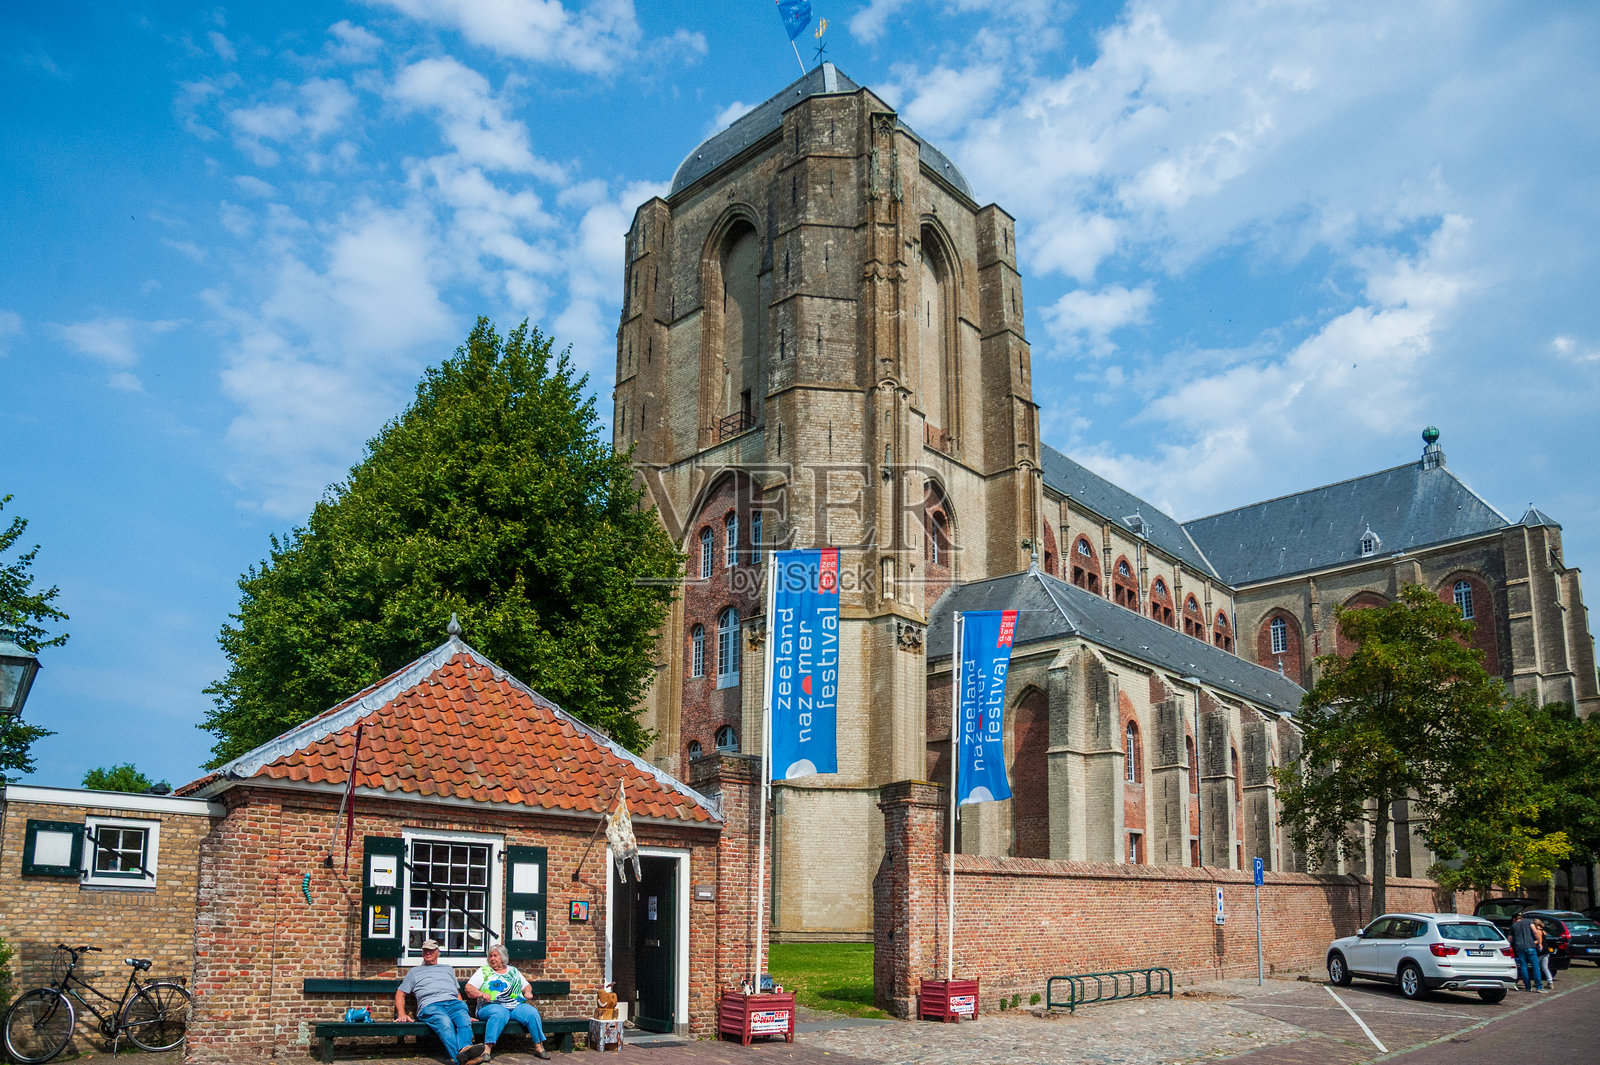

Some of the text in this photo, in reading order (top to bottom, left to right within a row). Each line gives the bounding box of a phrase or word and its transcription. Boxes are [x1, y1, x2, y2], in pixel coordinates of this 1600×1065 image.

[776, 607, 794, 710] zeeland
[816, 607, 837, 709] festival
[985, 657, 1009, 743] festival
[963, 659, 976, 745] zeeland
[1256, 860, 1262, 874] P
